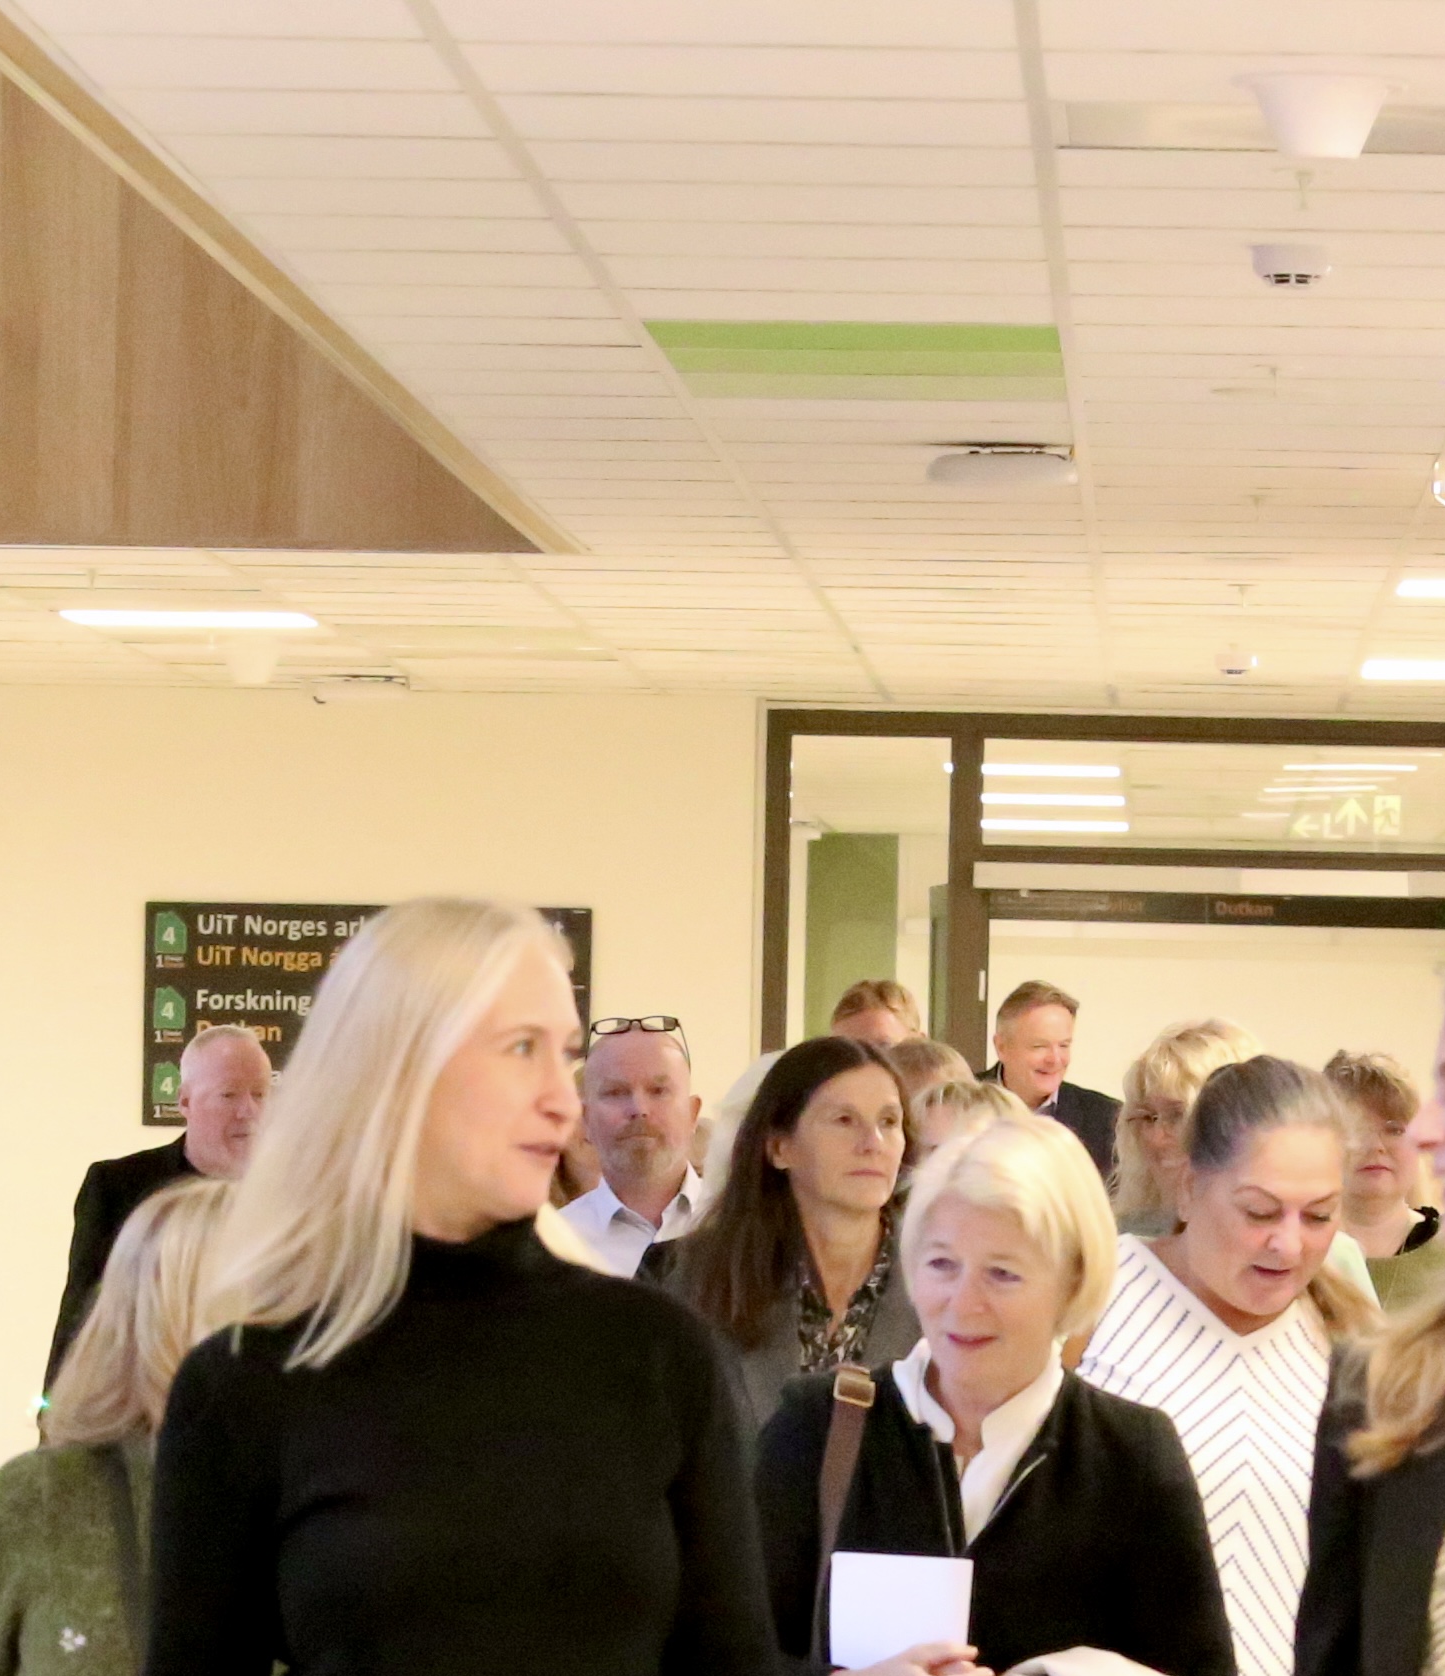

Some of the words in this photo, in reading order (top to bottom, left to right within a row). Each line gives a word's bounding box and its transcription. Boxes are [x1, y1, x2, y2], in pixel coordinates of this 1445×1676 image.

[162, 926, 176, 945] 4
[197, 913, 238, 935] UiT
[244, 914, 328, 941] Norges
[155, 954, 164, 968] 1
[197, 945, 236, 967] UiT
[241, 946, 322, 972] Norgga
[161, 1001, 175, 1020] 4
[196, 988, 312, 1016] Forskning
[154, 1030, 163, 1043] 1
[160, 1076, 174, 1095] 4
[153, 1104, 162, 1118] 1
